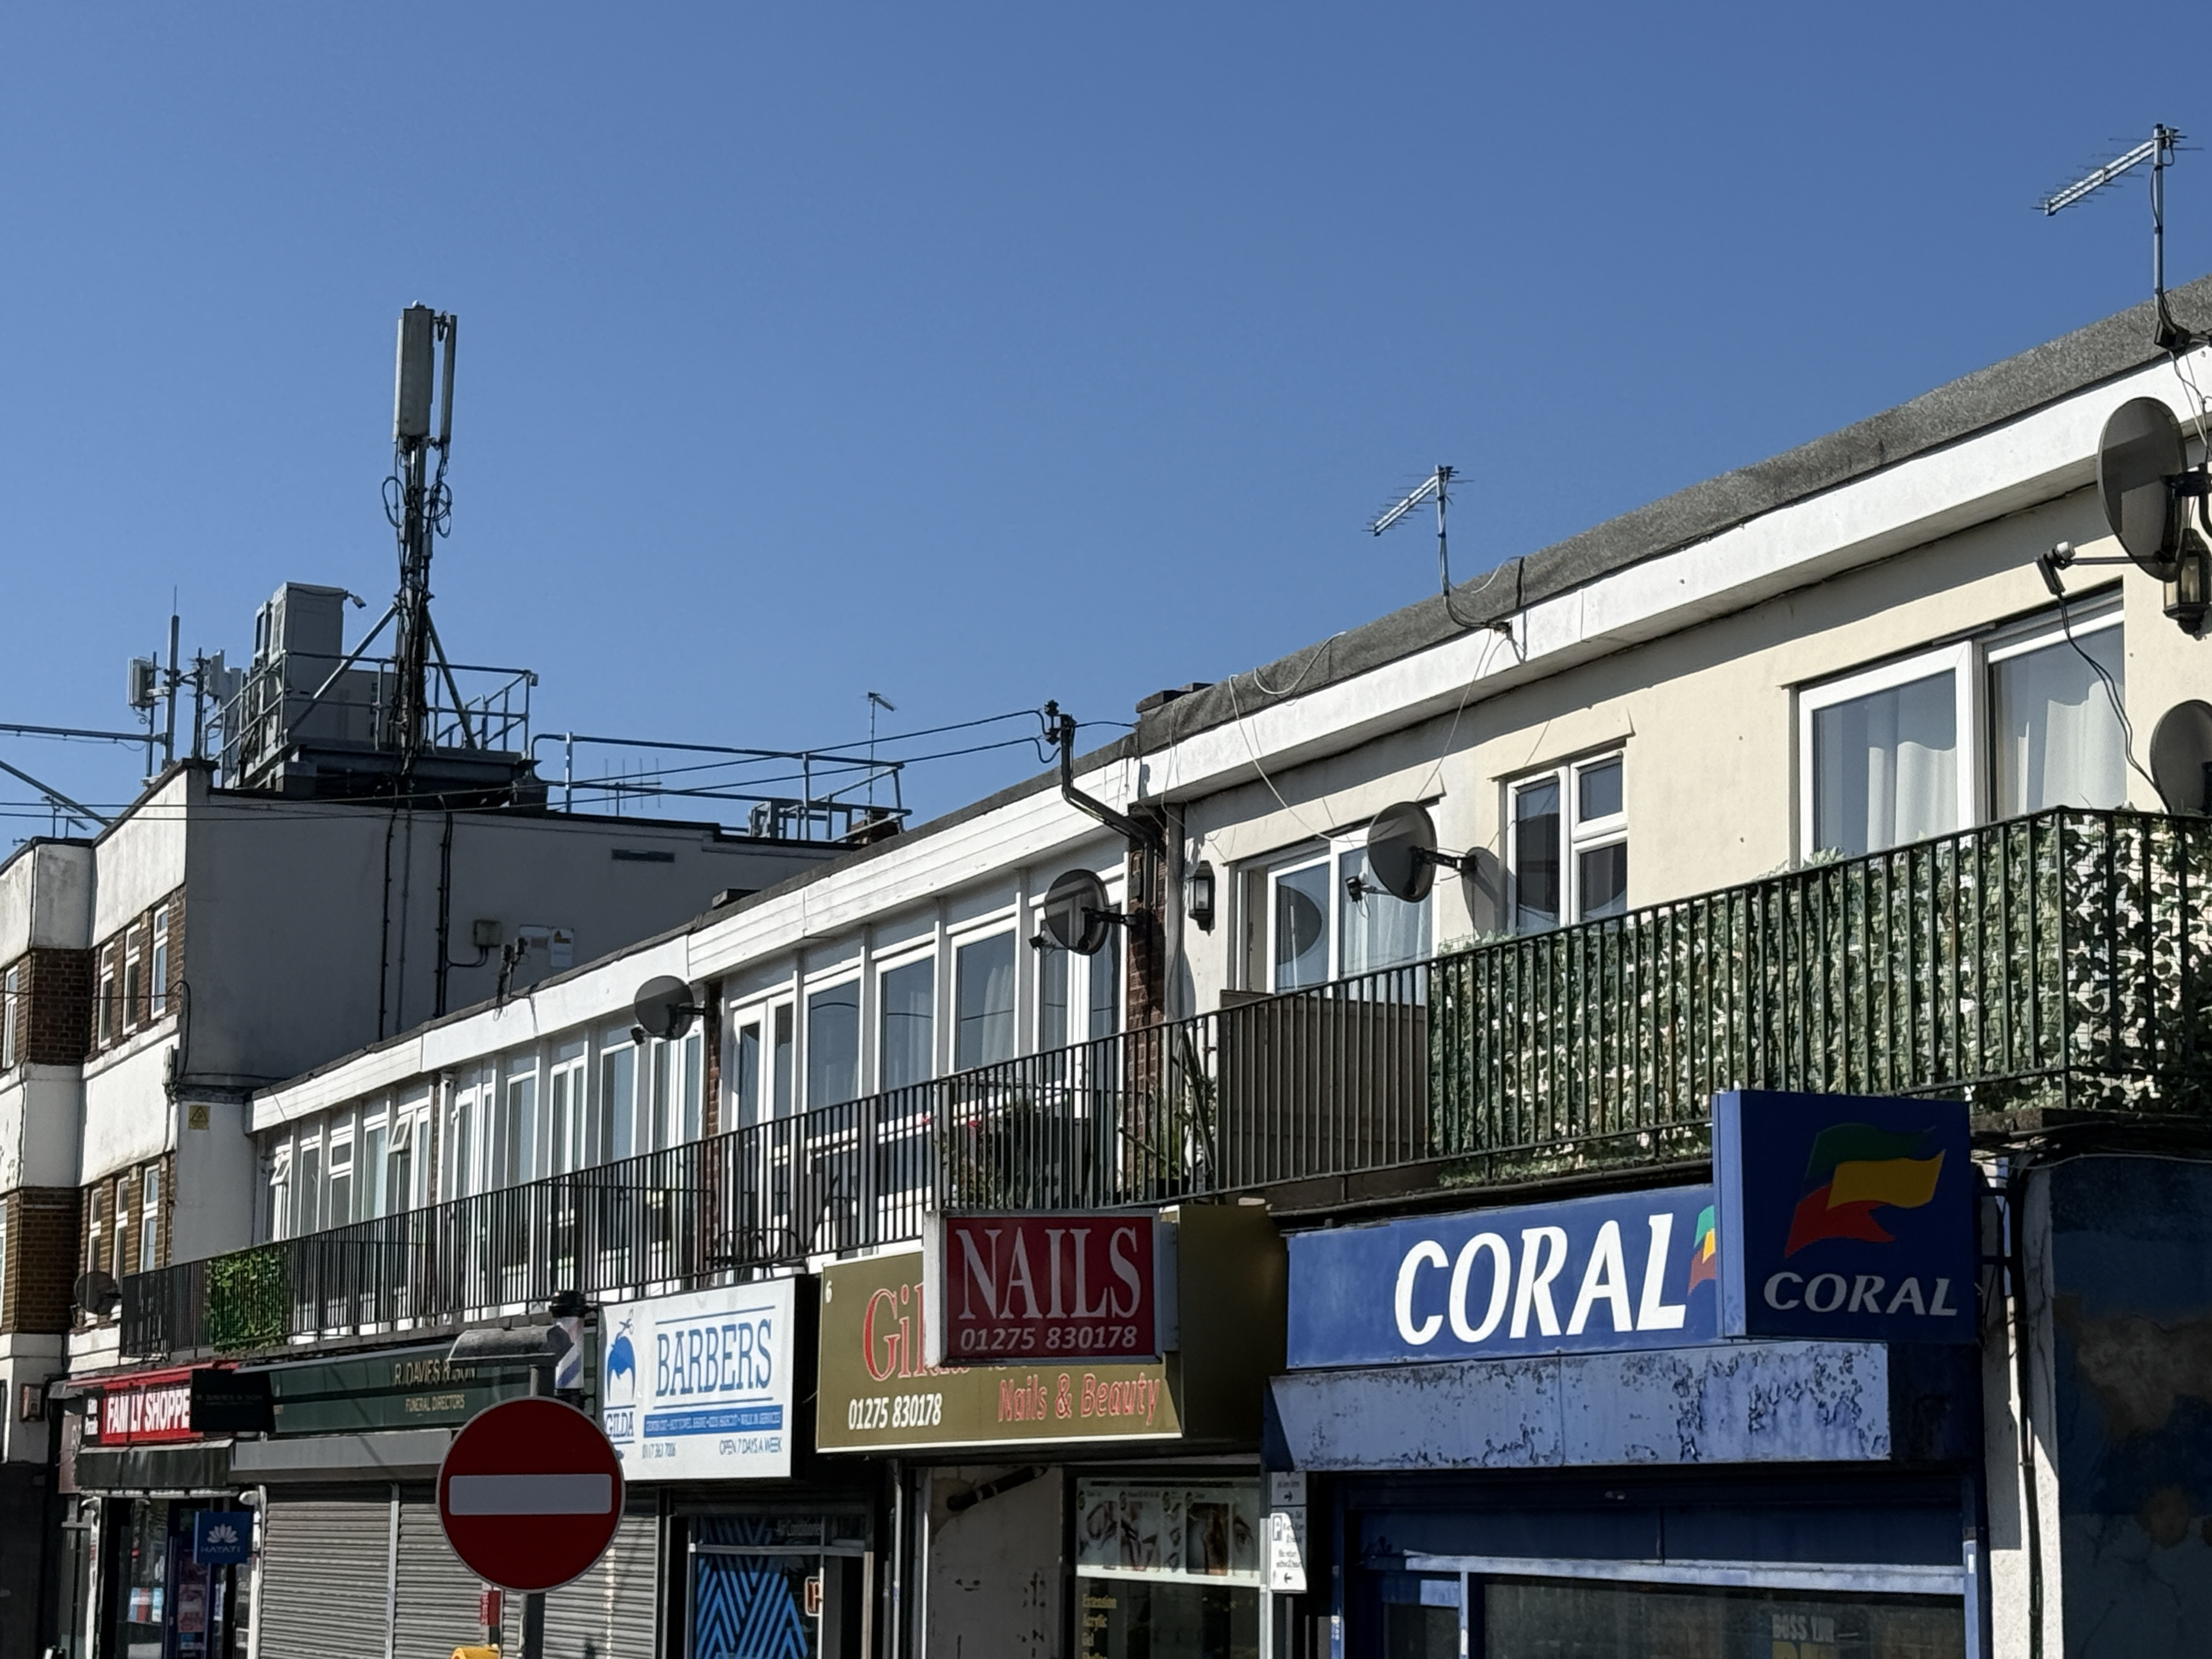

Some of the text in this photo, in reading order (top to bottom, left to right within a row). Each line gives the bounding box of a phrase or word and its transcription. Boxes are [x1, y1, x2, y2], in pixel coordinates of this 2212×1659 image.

[956, 1226, 1141, 1319] NAILS
[1394, 1212, 1686, 1345] CORAL
[825, 1280, 833, 1304] 6
[1763, 1272, 1959, 1317] CORAL
[961, 1325, 1138, 1352] 01275 830178
[406, 1359, 441, 1384] DAVIES
[655, 1318, 772, 1397] BARBERS
[405, 1394, 465, 1413] FUNERAL DIRECTORS
[848, 1393, 943, 1430] 01275 830178
[997, 1372, 1160, 1427] Nails & Beauty
[606, 1410, 635, 1438] GILDA
[719, 1438, 737, 1455] OPEN
